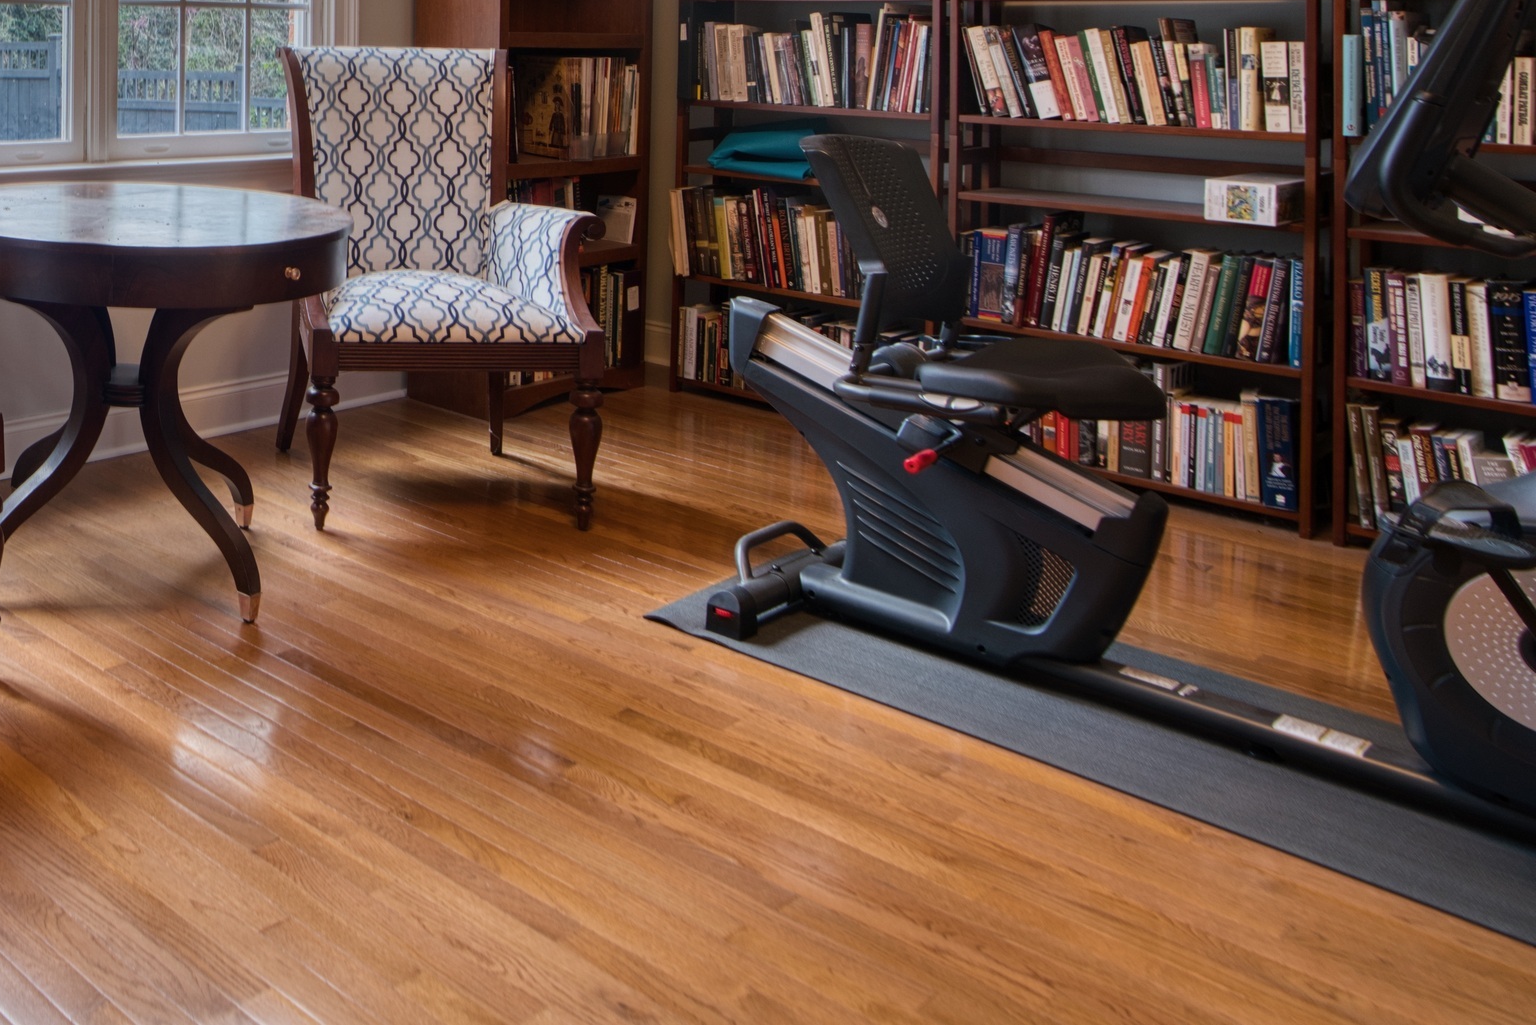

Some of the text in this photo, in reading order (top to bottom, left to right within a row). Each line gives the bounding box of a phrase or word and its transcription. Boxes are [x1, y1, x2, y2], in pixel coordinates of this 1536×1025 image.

[975, 32, 988, 52] 1759
[984, 59, 995, 81] FRANK
[1290, 68, 1301, 98] REBELS
[1517, 71, 1528, 125] COMBAT PATROL
[766, 222, 775, 250] HADRIAN'S
[777, 208, 794, 276] ROMAN BRITAIN
[1040, 232, 1048, 256] MEDIEVAL
[1015, 252, 1028, 296] MERCENARIES
[1046, 264, 1060, 302] HENRY II
[1075, 256, 1088, 293] THE FIRST CRUSADE
[1292, 261, 1303, 298] PIZARRO
[1370, 271, 1382, 294] SECRET
[598, 264, 607, 322] WORLD WAR
[1178, 260, 1204, 341] FEARFUL MAJESTY
[1261, 268, 1286, 348] MEDIEVAL MERCENARIES
[1406, 291, 1419, 330] GALLIPOLI
[1526, 294, 1536, 331] VICTORY
[1378, 328, 1386, 341] Taylor
[1410, 432, 1428, 484] ONE MAN WAR
